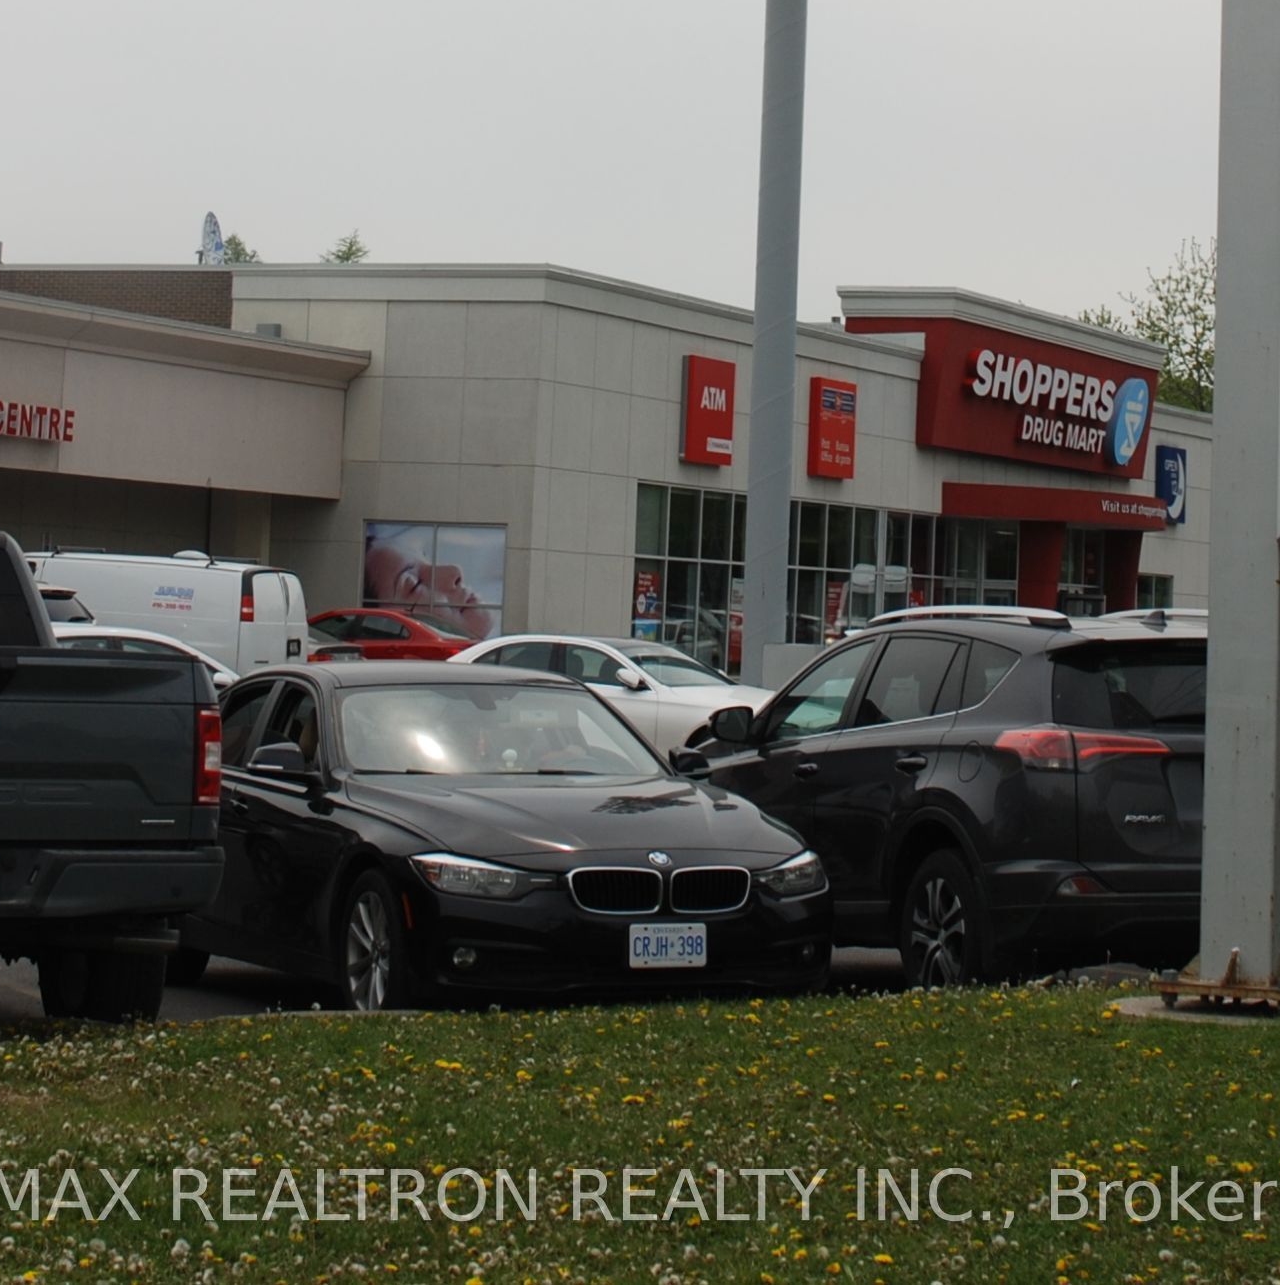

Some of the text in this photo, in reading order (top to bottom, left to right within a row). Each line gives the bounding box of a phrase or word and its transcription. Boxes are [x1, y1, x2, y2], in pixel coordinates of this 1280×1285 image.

[700, 386, 727, 412] ATM
[971, 349, 1117, 423] SHOPPERS
[1020, 415, 1107, 454] DRUG MART
[1101, 499, 1120, 513] Visit
[1121, 504, 1130, 514] us
[633, 935, 704, 957] CRJH 398
